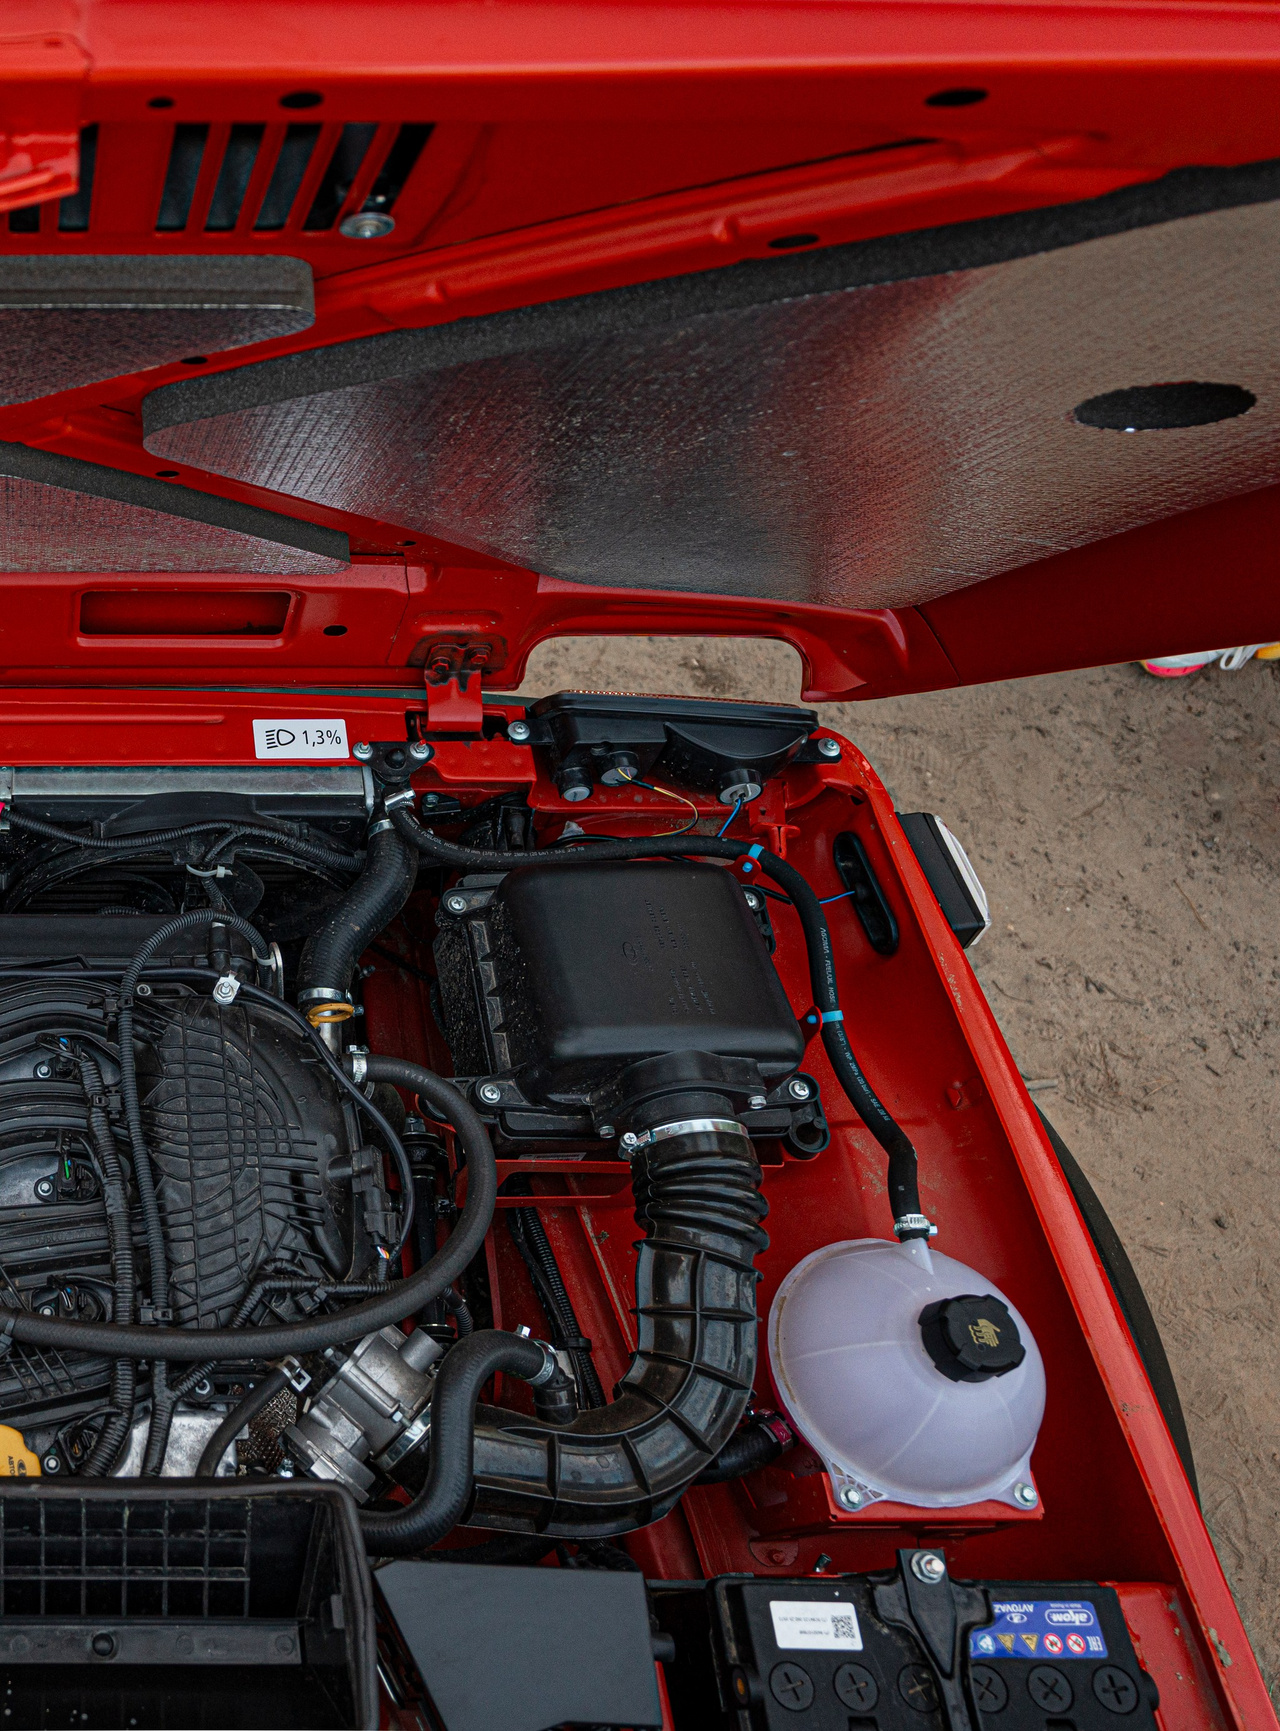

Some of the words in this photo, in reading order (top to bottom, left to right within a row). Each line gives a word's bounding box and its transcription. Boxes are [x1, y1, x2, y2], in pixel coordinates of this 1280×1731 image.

[302, 730, 342, 747] 1,3%
[993, 1603, 1034, 1613] AVTOVAZ
[1052, 1610, 1088, 1626] akom
